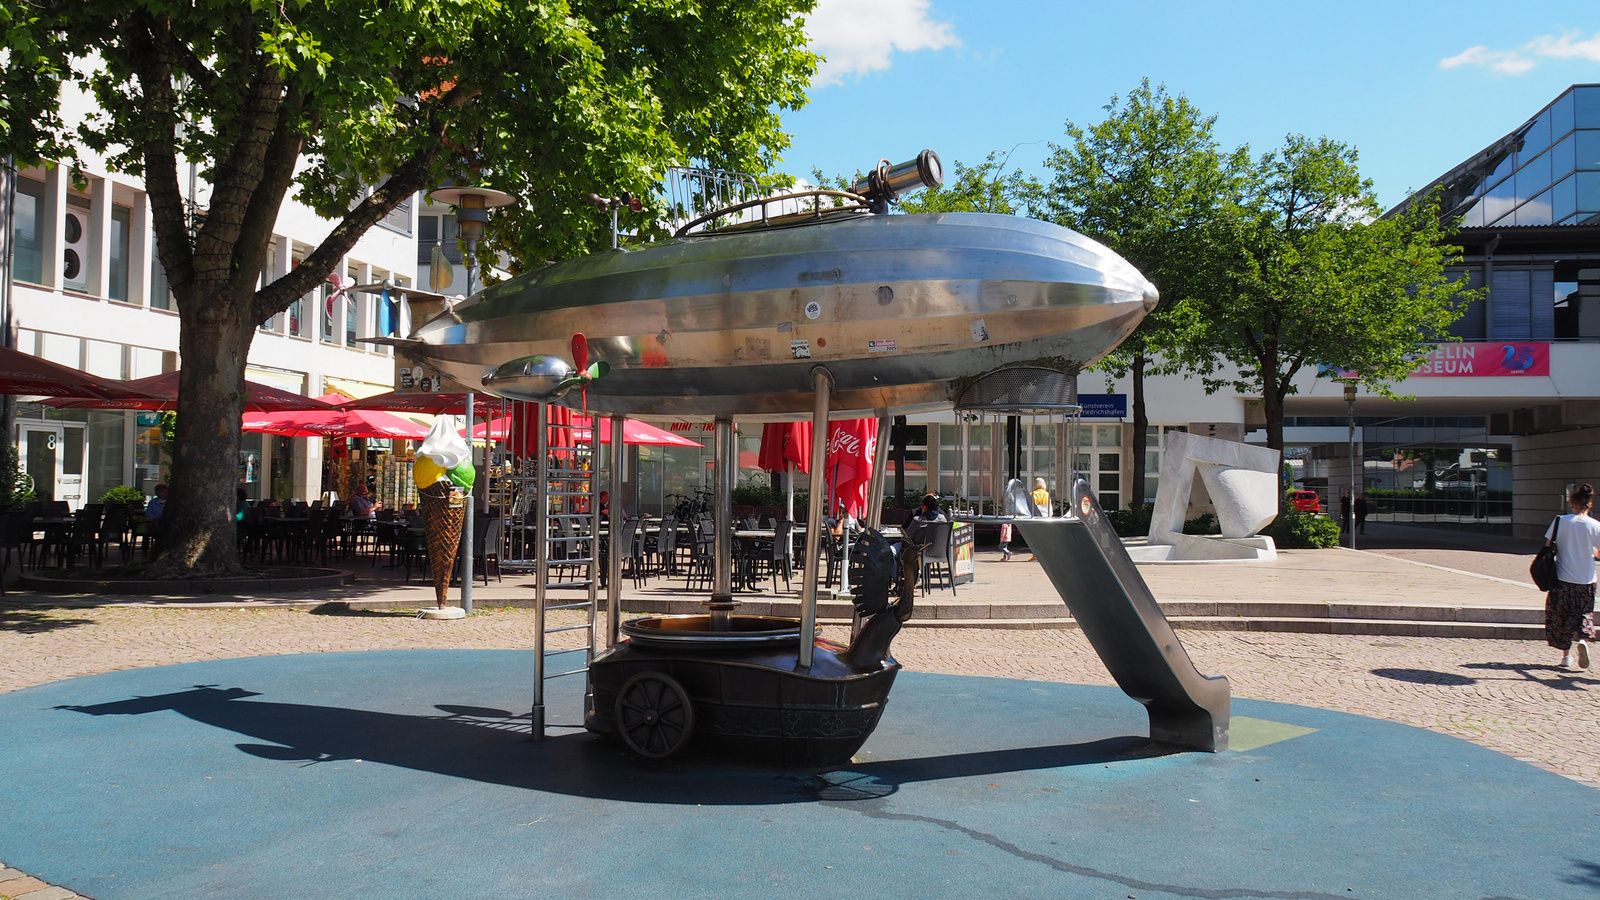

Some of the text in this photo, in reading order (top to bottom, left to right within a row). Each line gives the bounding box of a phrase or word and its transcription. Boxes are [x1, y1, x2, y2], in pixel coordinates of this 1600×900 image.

[1502, 345, 1536, 369] 25
[1411, 360, 1473, 373] USEUM
[669, 421, 692, 432] MINI
[47, 434, 57, 450] 8
